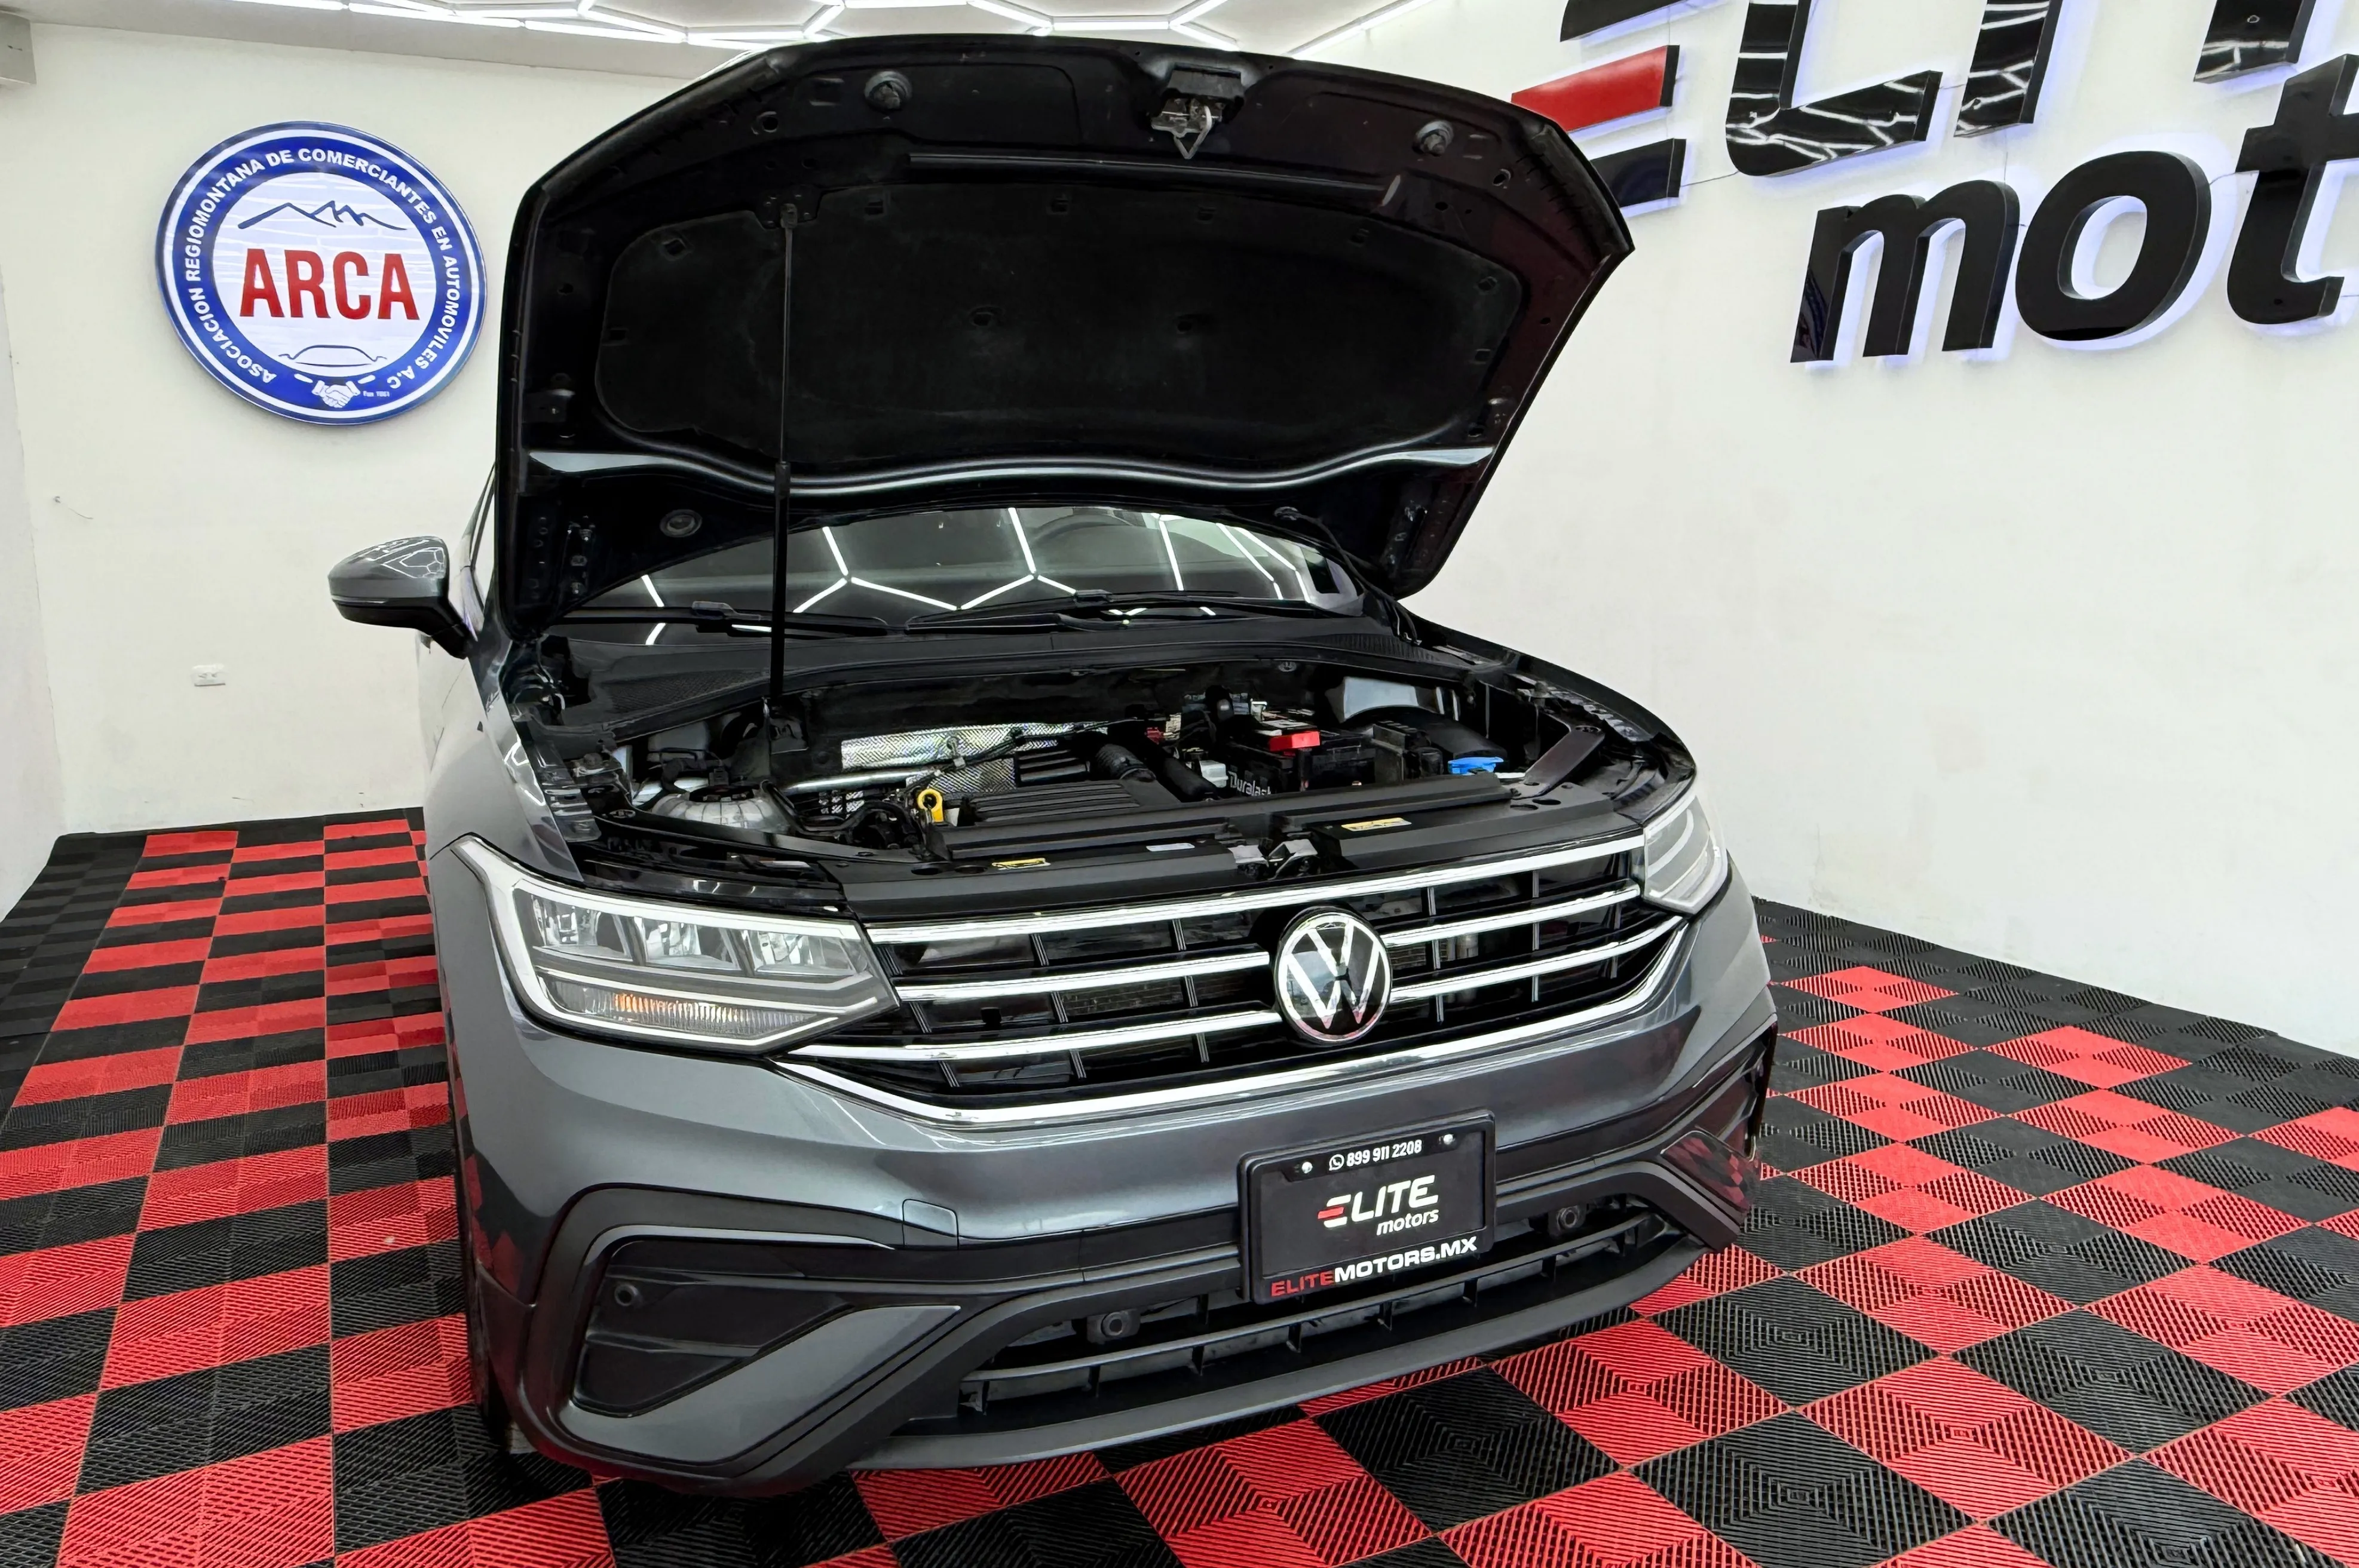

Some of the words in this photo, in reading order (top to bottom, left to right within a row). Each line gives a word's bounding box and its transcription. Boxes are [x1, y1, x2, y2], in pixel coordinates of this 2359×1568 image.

[266, 149, 294, 167] DE
[298, 148, 436, 224] COMERCIANTES
[185, 159, 265, 281] REGIOMONTANA
[431, 226, 452, 251] EN
[240, 248, 420, 320] ARCA
[415, 256, 460, 369] AUTOMOVILES
[188, 287, 277, 383] ASOCIACION
[1347, 1149, 1371, 1167] 899
[1372, 1140, 1390, 1162] 911
[1392, 1139, 1422, 1158] 2208
[1318, 1174, 1439, 1228] ELITE
[1376, 1209, 1439, 1236] motors
[1271, 1236, 1477, 1297] ELITEMOTORS.MX
